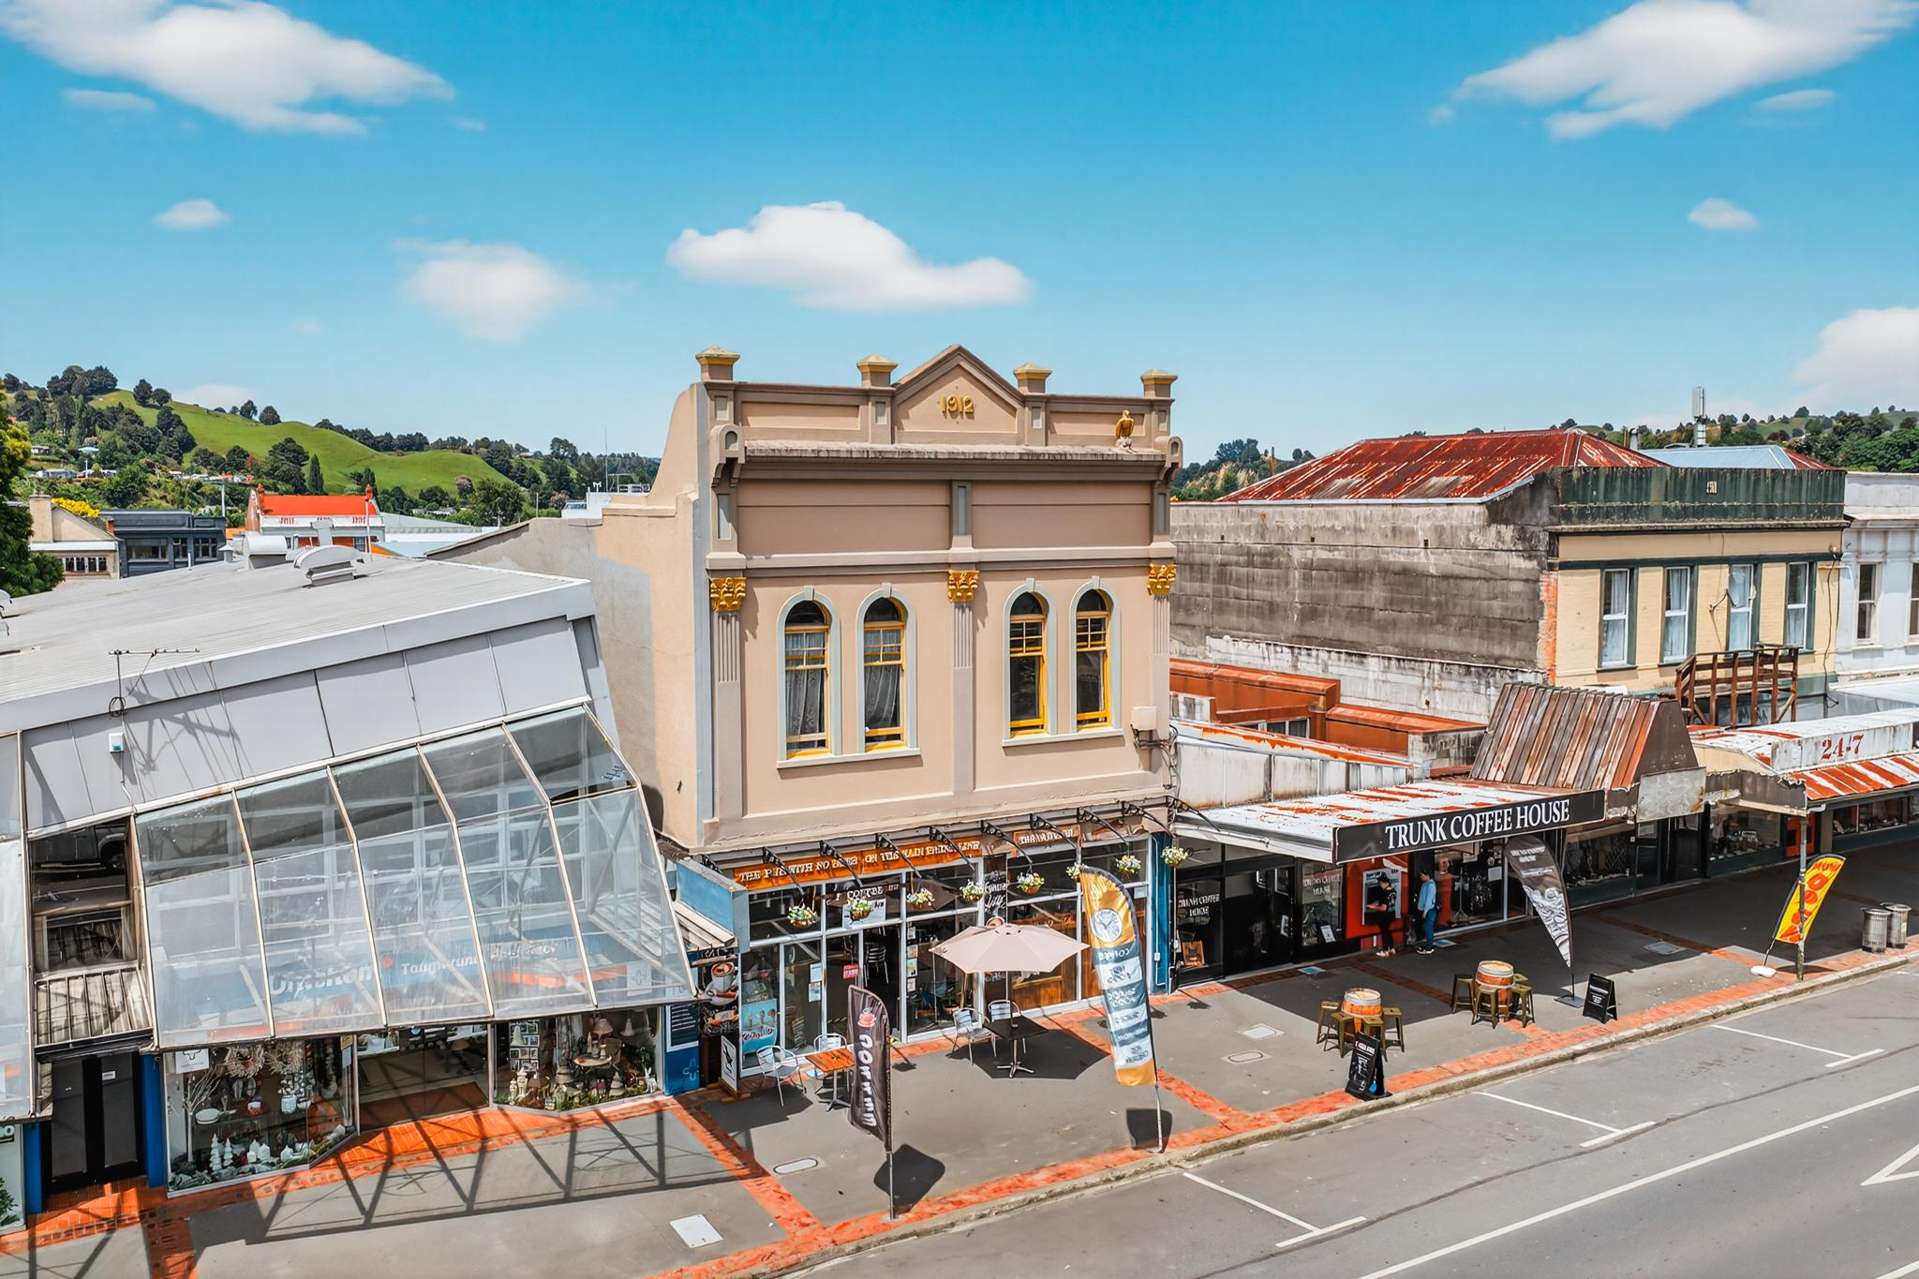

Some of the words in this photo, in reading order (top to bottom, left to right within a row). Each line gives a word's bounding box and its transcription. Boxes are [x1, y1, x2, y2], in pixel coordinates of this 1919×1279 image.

[939, 394, 974, 414] 1912
[1384, 816, 1447, 850] TRUNK
[1450, 807, 1513, 840] COFFEE
[1516, 799, 1570, 829] HOUSE
[815, 859, 830, 871] NO
[857, 1033, 877, 1127] COFFEE
